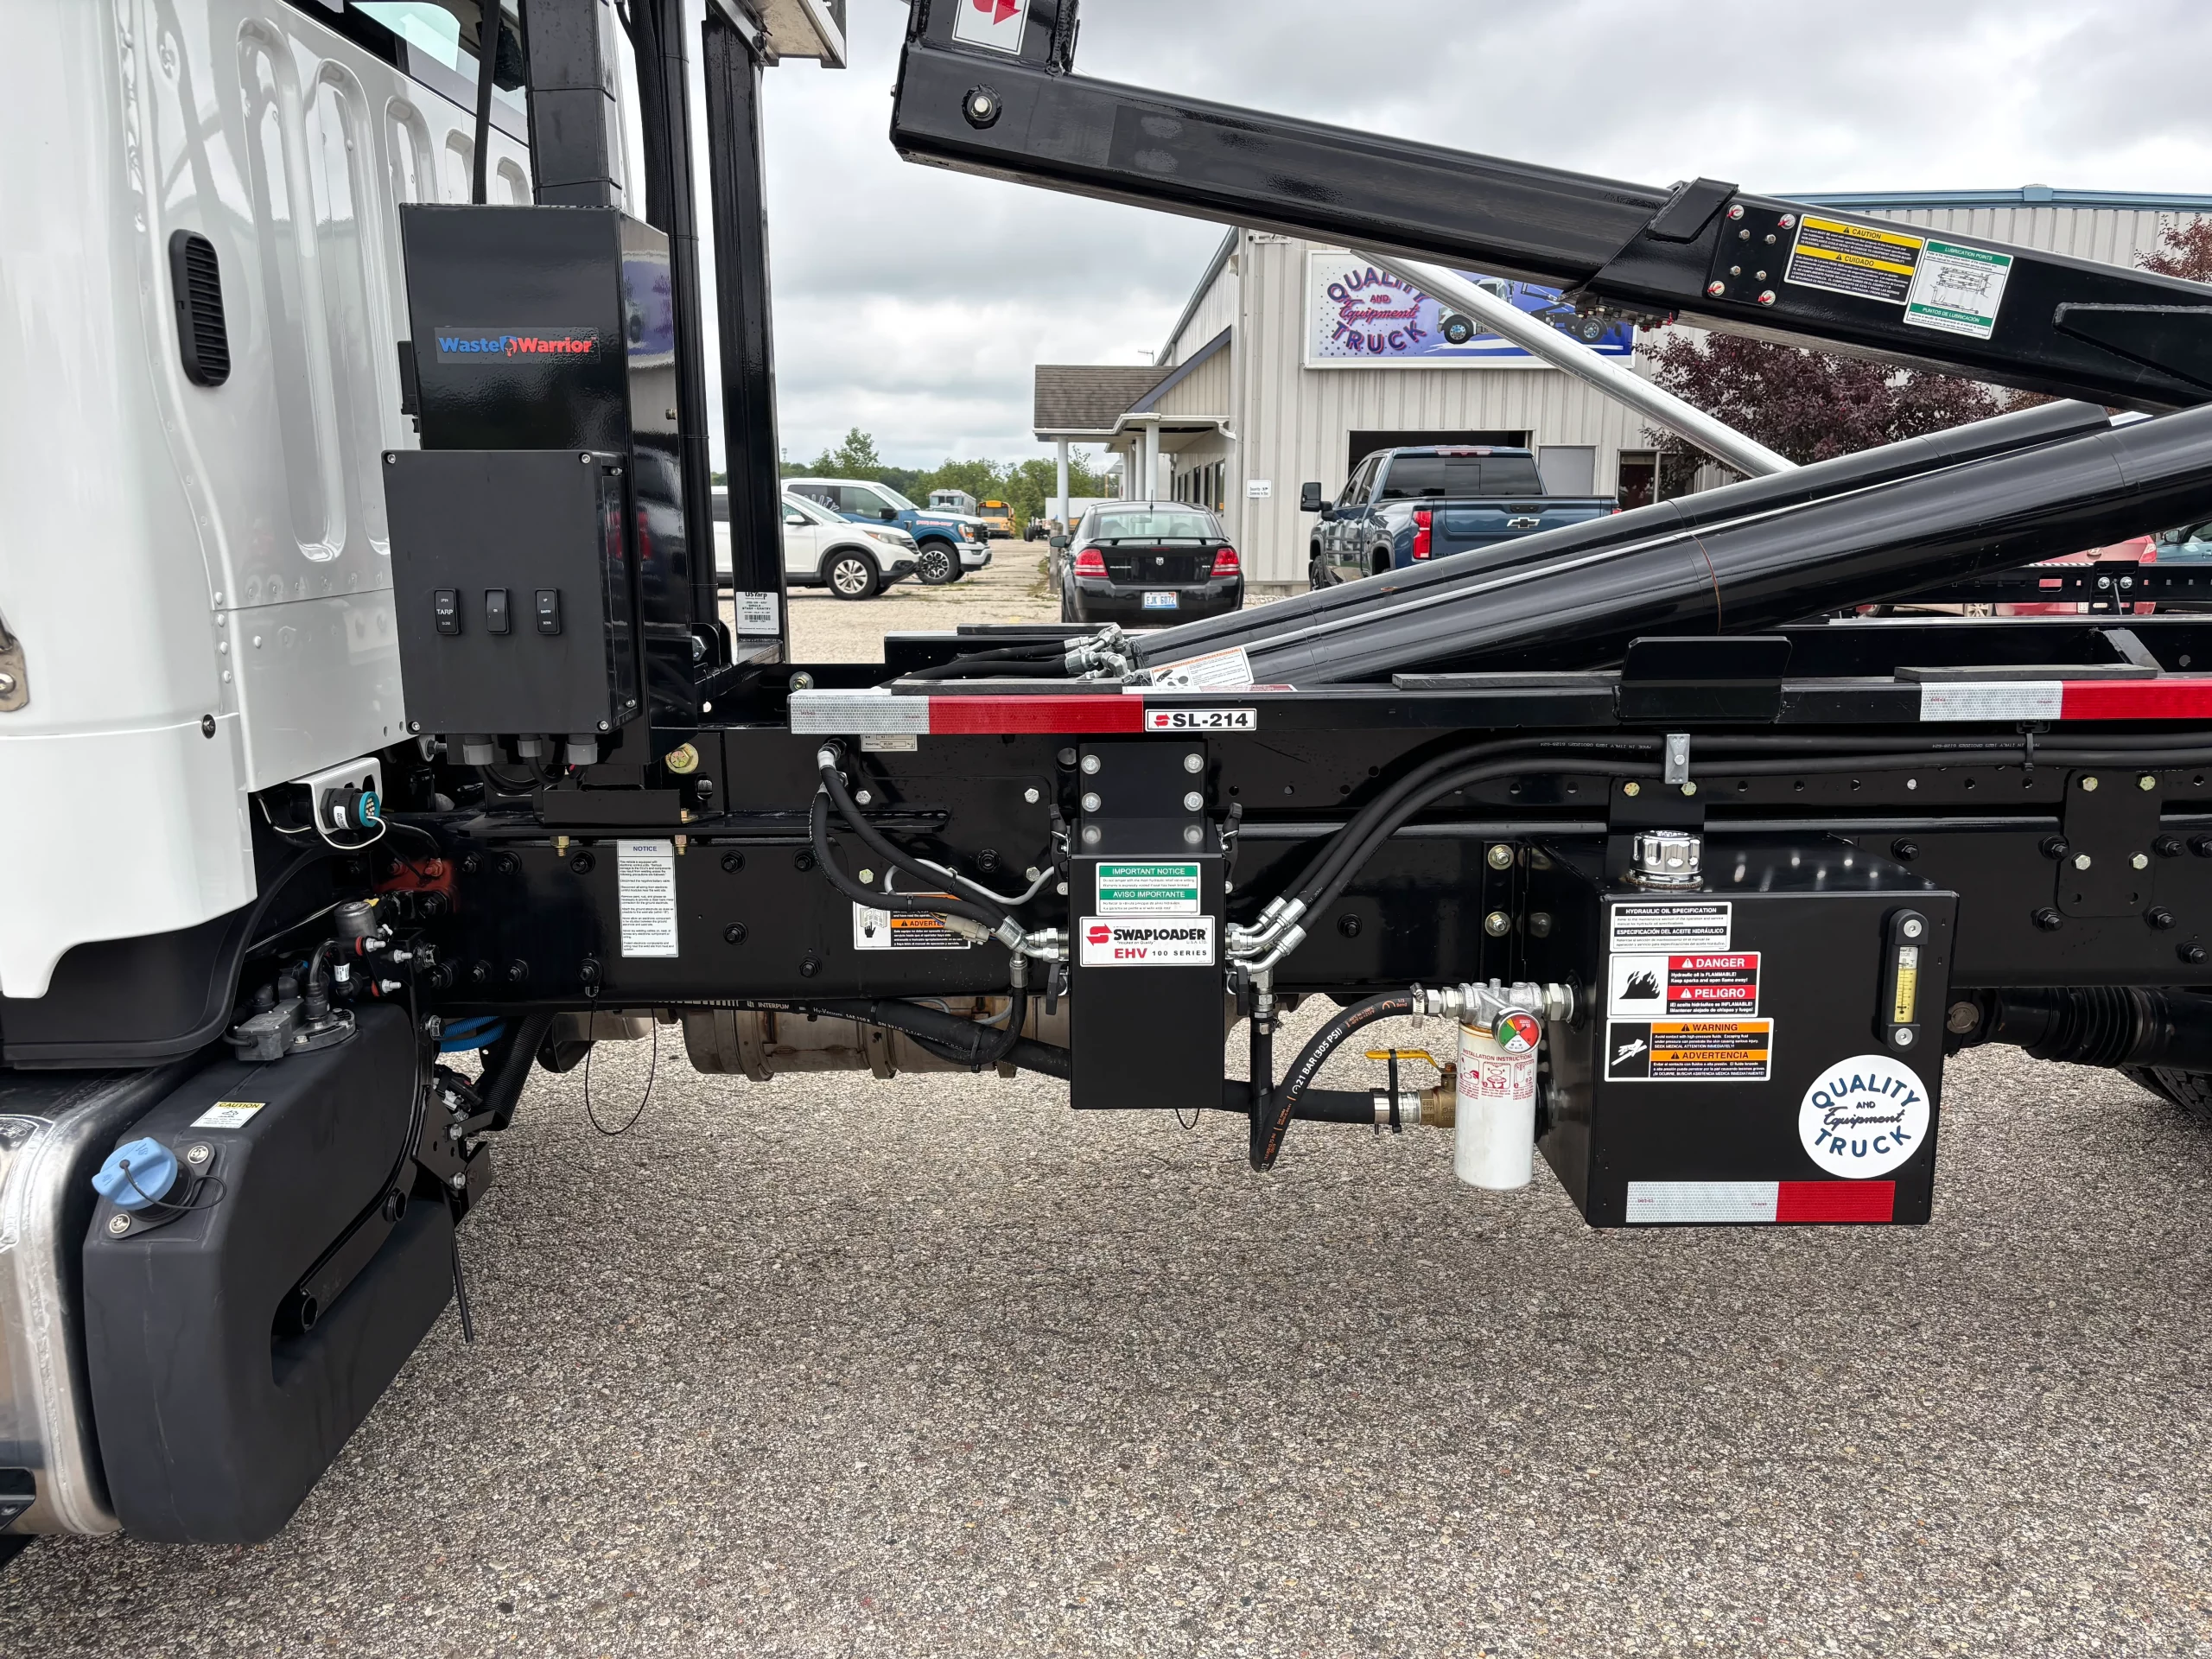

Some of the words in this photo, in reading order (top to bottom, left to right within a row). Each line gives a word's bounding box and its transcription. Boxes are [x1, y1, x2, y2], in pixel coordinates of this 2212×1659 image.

[1853, 229, 1882, 239] CAUTION
[1945, 247, 1975, 257] LUBRICATION
[1844, 256, 1874, 266] CUIDADO
[1370, 294, 1391, 303] AND
[1339, 299, 1420, 326] Equipment
[1949, 312, 1980, 322] LUBRICACIÓN
[1331, 320, 1427, 353] TRUCK
[439, 337, 499, 353] Waste
[517, 337, 593, 353] Warrior
[1173, 713, 1248, 727] SL-214
[1114, 928, 1206, 940] SWAPLOADER
[1115, 948, 1147, 959] EHV
[1696, 958, 1745, 967] DANGER
[1695, 988, 1745, 998] PELIGRO
[1296, 1075, 1306, 1086] 21
[1302, 1057, 1318, 1075] BAR
[1314, 1041, 1330, 1059] (305
[1326, 1027, 1343, 1044] PSI)
[1463, 1048, 1495, 1060] INSTALLATION
[1812, 1074, 1921, 1109] QUALITY
[1823, 1106, 1905, 1131] Equipment
[1815, 1125, 1912, 1157] TRUCK
